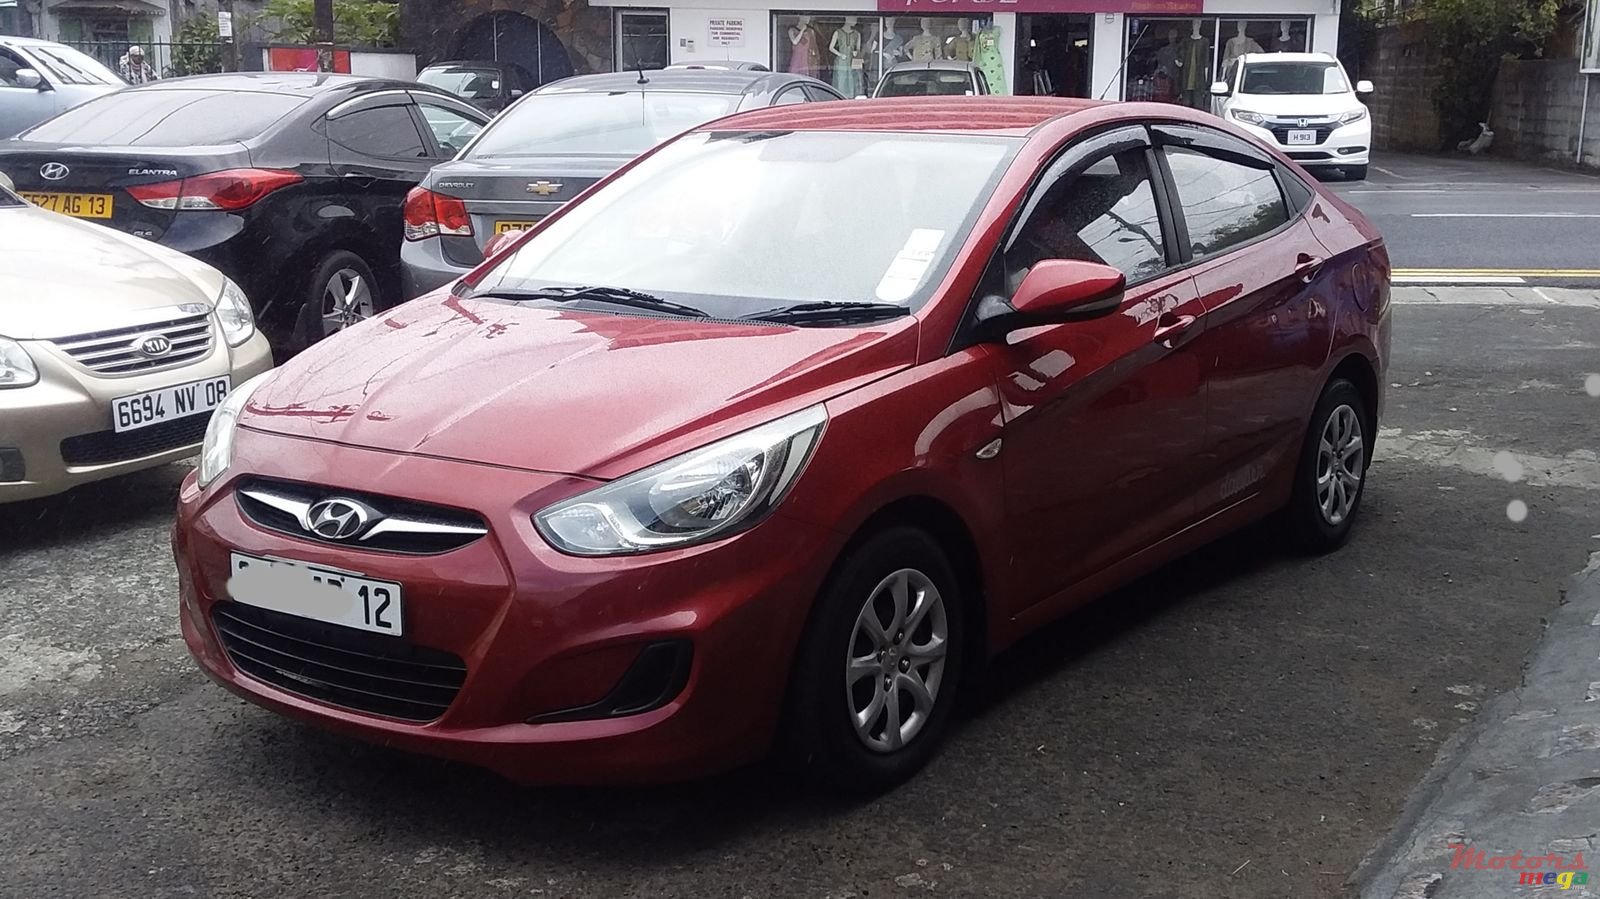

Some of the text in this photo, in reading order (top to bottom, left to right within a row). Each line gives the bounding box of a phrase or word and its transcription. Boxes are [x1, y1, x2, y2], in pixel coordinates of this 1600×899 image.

[128, 168, 178, 177] ELANTRA
[63, 195, 81, 214] AG
[88, 197, 105, 215] 13
[144, 338, 168, 353] KIA
[118, 380, 227, 428] 6694 NV 08
[358, 585, 393, 629] 12
